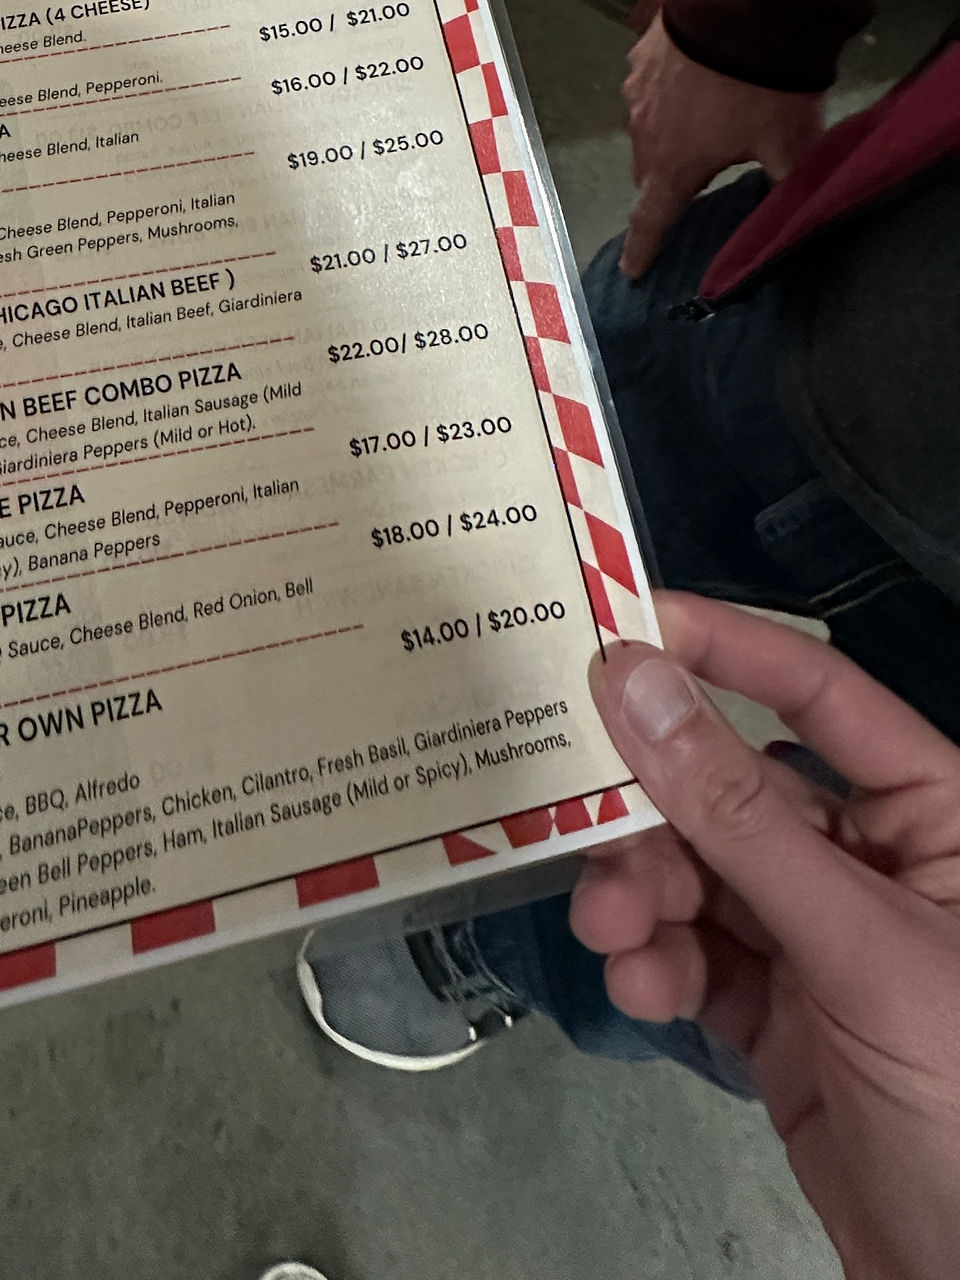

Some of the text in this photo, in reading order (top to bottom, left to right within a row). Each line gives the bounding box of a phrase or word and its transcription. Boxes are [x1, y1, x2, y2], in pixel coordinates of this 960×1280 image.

[45, 6, 67, 26] (4
[258, 2, 410, 43] $15.00 / $21.00
[43, 29, 87, 48] Blend.
[270, 55, 424, 97] $16.00 / $22.00
[287, 129, 444, 171] $19.00 / $25.00
[26, 242, 74, 260] Green
[77, 232, 143, 253] Peppers,
[147, 216, 239, 241] Mushrooms,
[309, 233, 468, 275] $21.00 / $27.00
[83, 280, 167, 312] ITALIAN
[170, 272, 220, 297] BEEF
[224, 267, 236, 291] )
[327, 323, 489, 365] $22.00/ $28.00
[22, 388, 77, 418] BEEF
[84, 373, 173, 407] COMBO
[177, 361, 243, 391] PIZZA
[348, 415, 513, 459] $17.00 / $23.00
[17, 483, 86, 516] PIZZA
[370, 504, 538, 551] $18.00 / $24.00
[27, 548, 89, 573] Banana
[93, 533, 161, 560] Peppers
[0, 591, 73, 628] PIZZA
[7, 635, 65, 660] Sauce,
[69, 619, 134, 646] Cheese
[138, 602, 189, 633] Blend,
[193, 595, 225, 620] Red
[228, 587, 282, 611] Onion,
[284, 576, 314, 599] Bell
[400, 600, 566, 654] $14.00 / $20.00
[17, 703, 85, 744] OWN
[89, 688, 164, 727] PIZZA
[317, 747, 365, 778] Fresh
[413, 717, 503, 753] Giardiniera
[503, 700, 569, 729] Peppers
[74, 770, 140, 805] Alfredo
[37, 855, 72, 885] Bell
[211, 810, 266, 840] Italian
[269, 791, 343, 824] Sausage
[346, 773, 390, 808] (Mild
[393, 773, 410, 792] or
